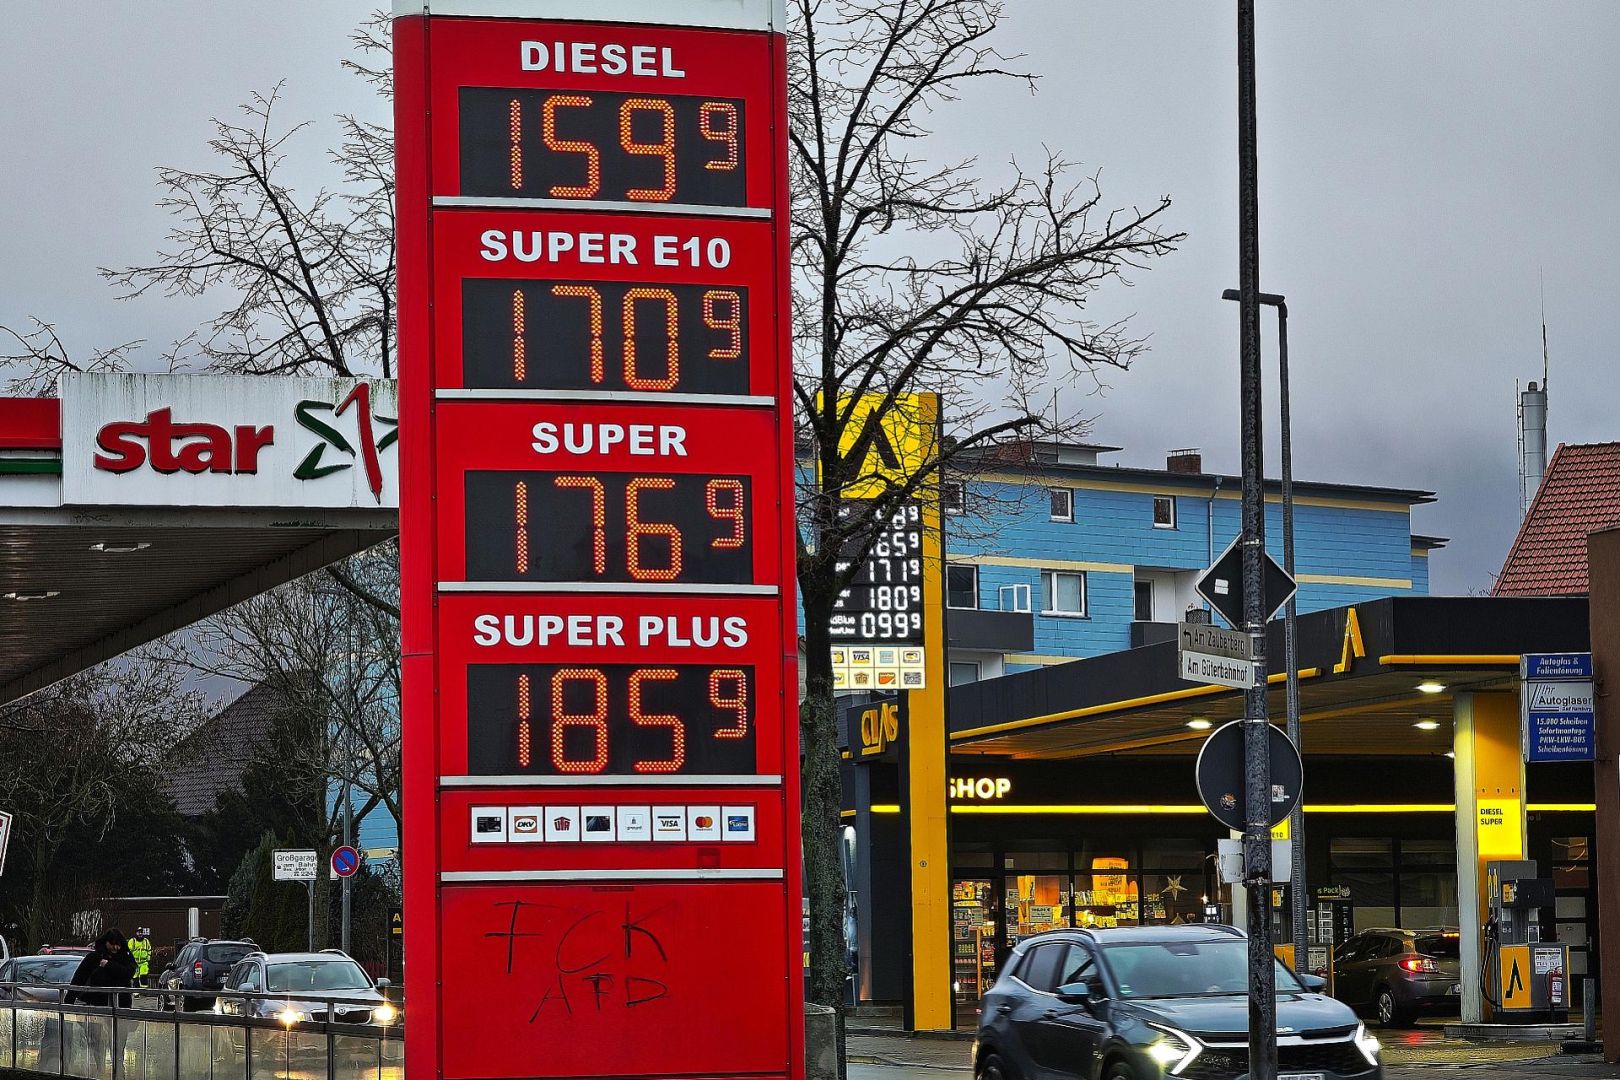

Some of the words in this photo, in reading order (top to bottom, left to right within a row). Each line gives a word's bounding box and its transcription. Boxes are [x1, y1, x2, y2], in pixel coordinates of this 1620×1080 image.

[520, 40, 686, 78] DIESEL
[479, 229, 639, 266] SUPER
[653, 236, 731, 268] E10
[93, 406, 274, 475] star
[531, 422, 688, 457] SUPER
[473, 613, 625, 647] SUPER
[639, 616, 748, 648] PLUS
[1194, 630, 1204, 646] Am
[1208, 631, 1245, 655] Zauberberg
[1188, 658, 1198, 675] Am
[1202, 659, 1248, 682] Güterbahnhof
[1539, 695, 1592, 706] Autoglaser
[861, 703, 898, 755] CLAS
[1480, 808, 1503, 816] DIESEL
[1480, 818, 1503, 826] SUPER
[277, 854, 317, 862] Großgarag
[484, 899, 678, 975] FCK
